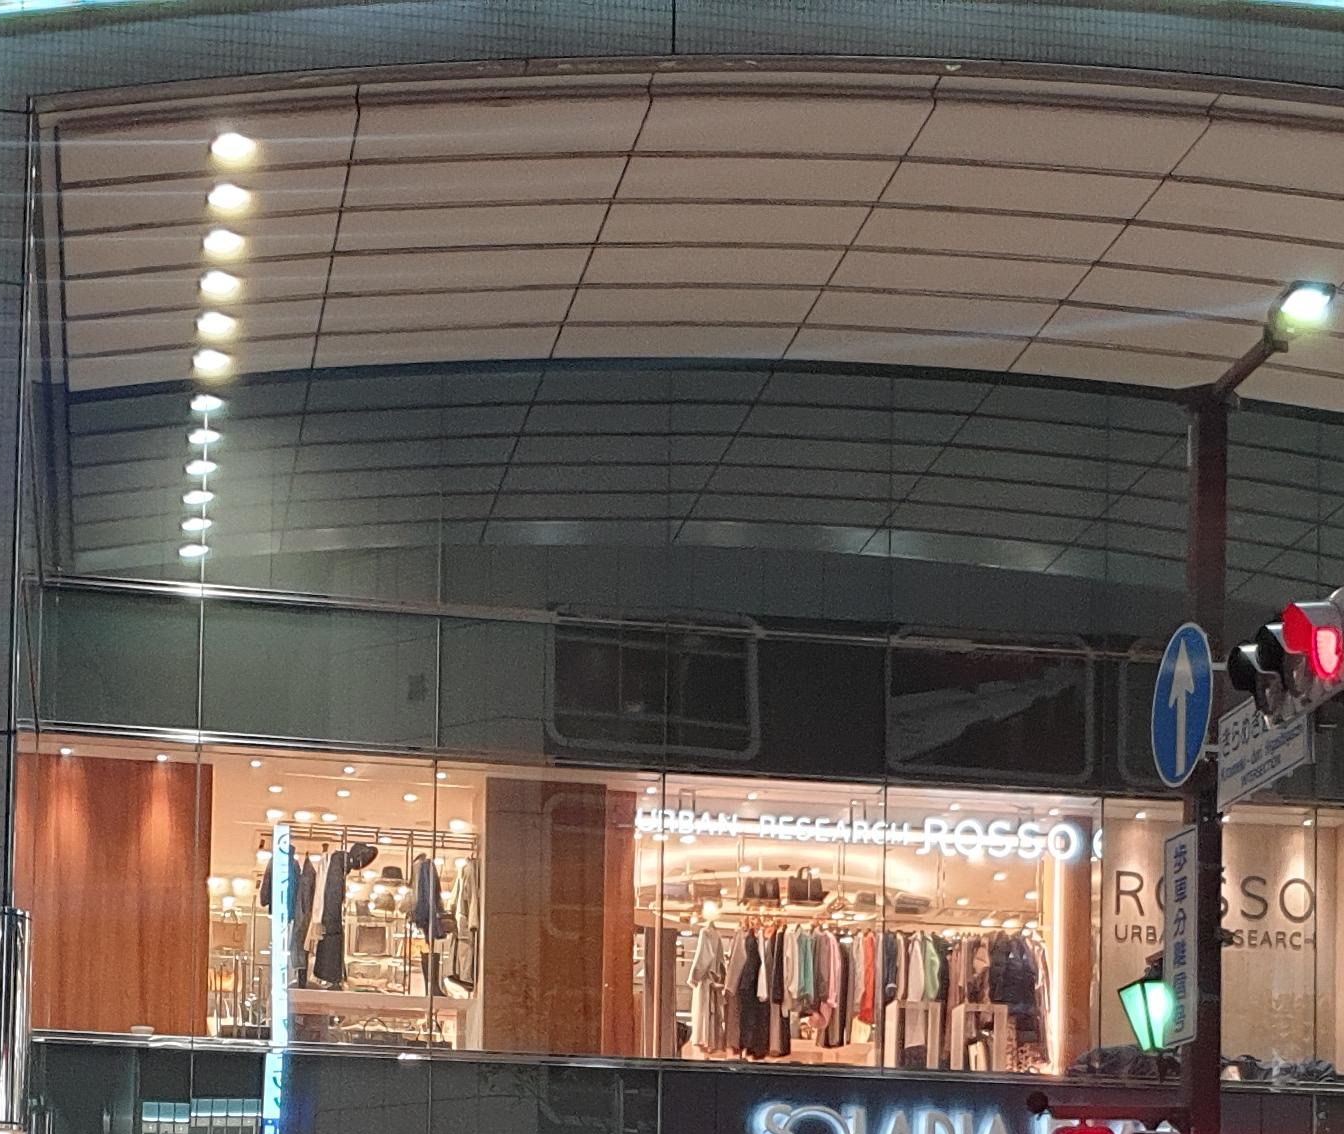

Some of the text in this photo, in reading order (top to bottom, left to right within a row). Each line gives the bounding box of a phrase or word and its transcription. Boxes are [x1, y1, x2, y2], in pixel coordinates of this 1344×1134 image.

[635, 807, 1080, 861] URBAN RESEARCH ROSSO
[1115, 870, 1316, 924] RSO
